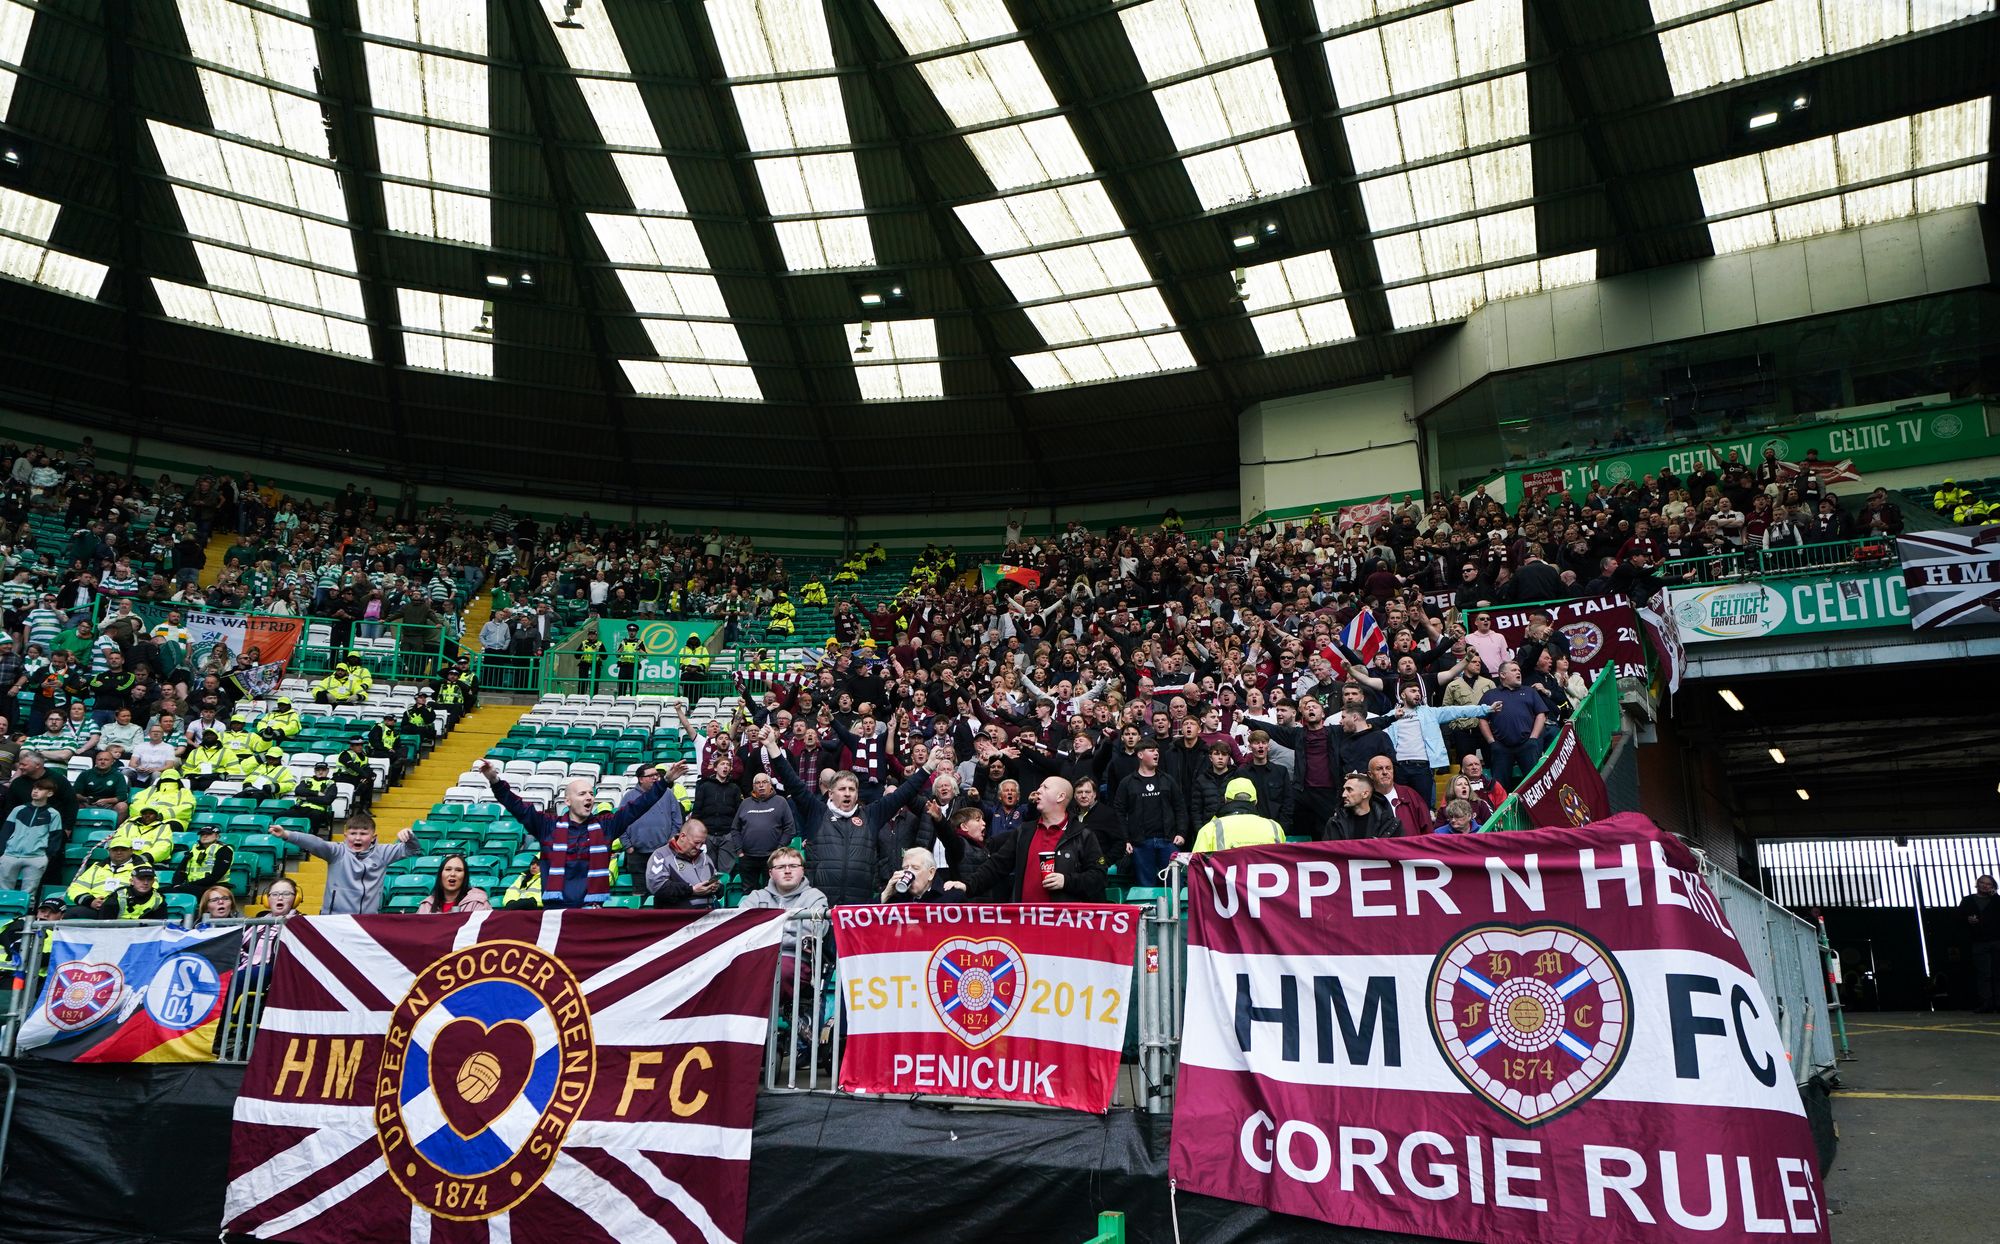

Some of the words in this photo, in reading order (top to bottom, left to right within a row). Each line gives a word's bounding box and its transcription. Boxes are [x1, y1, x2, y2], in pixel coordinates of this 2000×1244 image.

[1829, 423, 1891, 454] CELTIC
[1896, 418, 1922, 445] TV
[1668, 448, 1723, 475] CELTIC
[1496, 607, 1564, 629] BILY
[1711, 596, 1769, 618] CELTICFC
[1792, 575, 1910, 625] CELTIC
[221, 617, 296, 632] WALFRID
[1711, 614, 1758, 627] TRAVEL.COM
[1523, 779, 1547, 808] HEART
[1543, 771, 1554, 790] OF
[1549, 728, 1577, 781] MIDLOTHIAN
[1205, 857, 1462, 920] UPPER
[1485, 853, 1546, 913] N
[838, 906, 919, 930] ROYAL
[926, 905, 1012, 925] HOTEL
[1018, 906, 1131, 934] HEARTS
[436, 948, 555, 991] SOCCER
[407, 987, 430, 1017] N
[849, 975, 918, 1011] EST:
[1030, 979, 1122, 1025] 2012
[61, 1010, 84, 1019] 1874
[962, 1012, 989, 1026] 1874
[1234, 972, 1402, 1068] HM
[1666, 972, 1778, 1087] FC
[273, 1038, 364, 1099] HM
[615, 1047, 713, 1117] FC
[529, 980, 589, 1160] TRENDIES
[893, 1054, 1059, 1098] PENICUIK
[1503, 1058, 1554, 1081] 1874
[379, 1025, 408, 1153] UPPER
[1240, 1109, 1548, 1213] GORGIE
[434, 1180, 488, 1211] 1874
